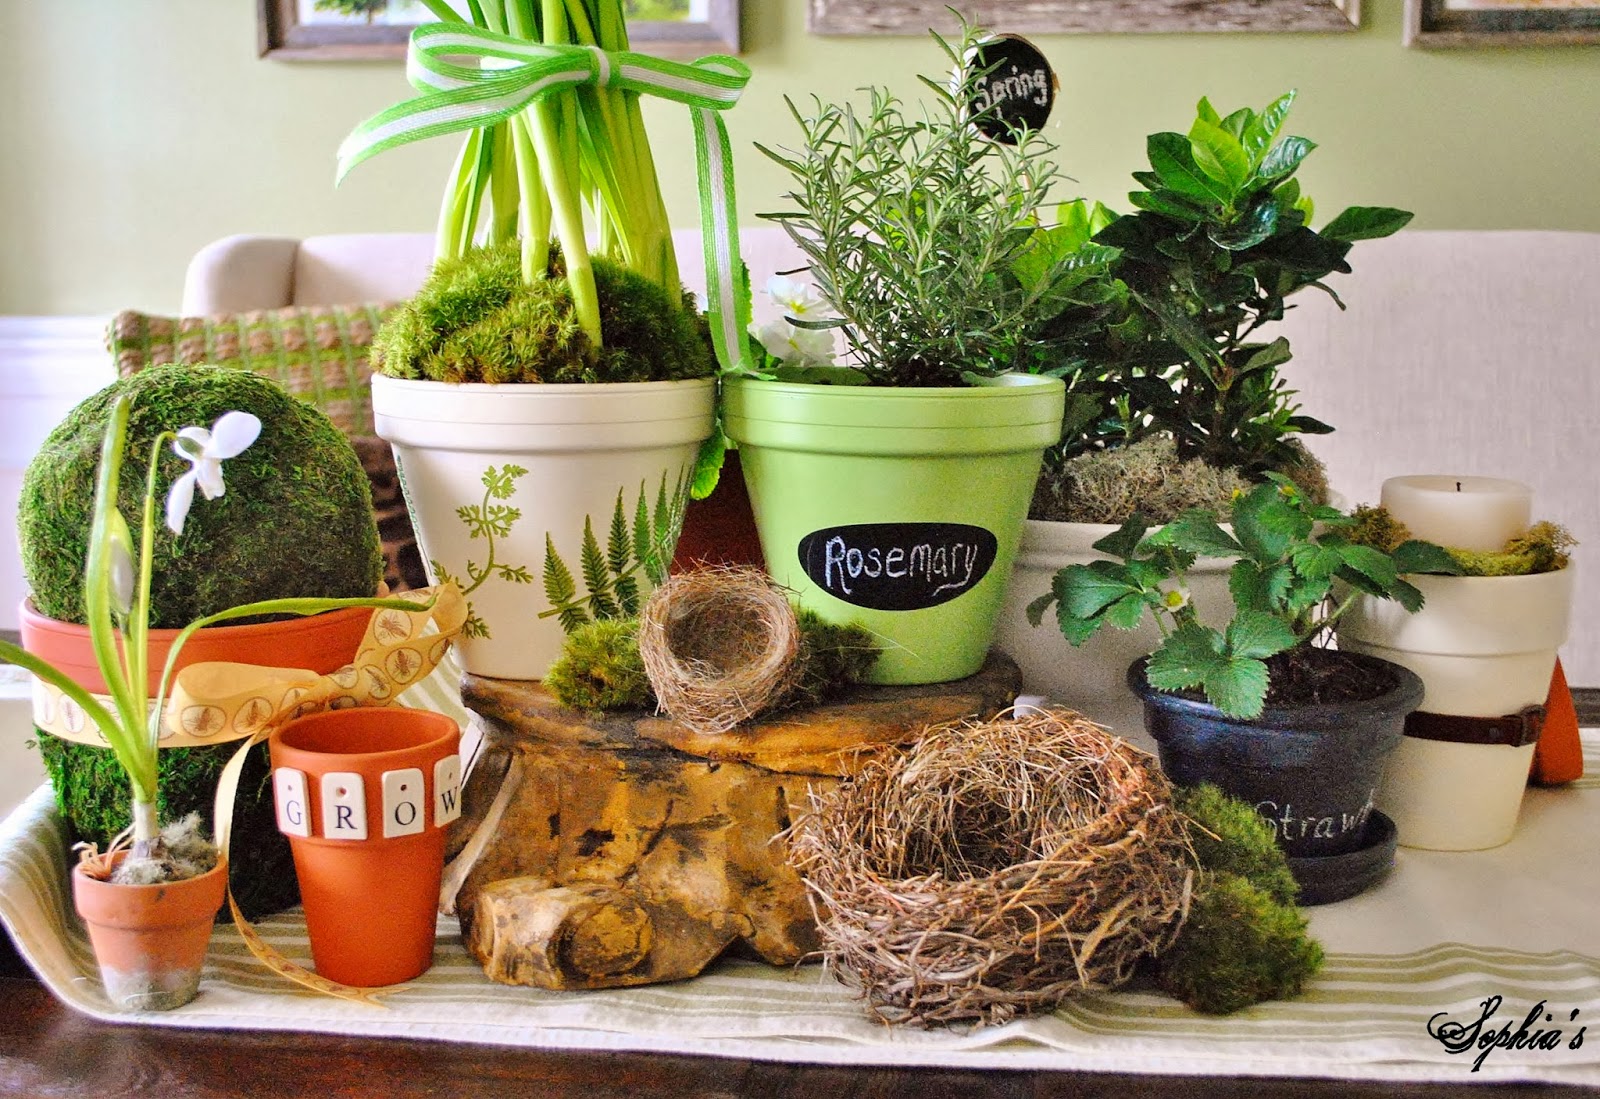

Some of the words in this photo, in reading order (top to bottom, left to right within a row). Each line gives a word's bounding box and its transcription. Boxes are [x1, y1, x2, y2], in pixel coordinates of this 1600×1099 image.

[975, 65, 1048, 119] Spring
[825, 535, 978, 597] Rosemary
[286, 786, 458, 830] GROW
